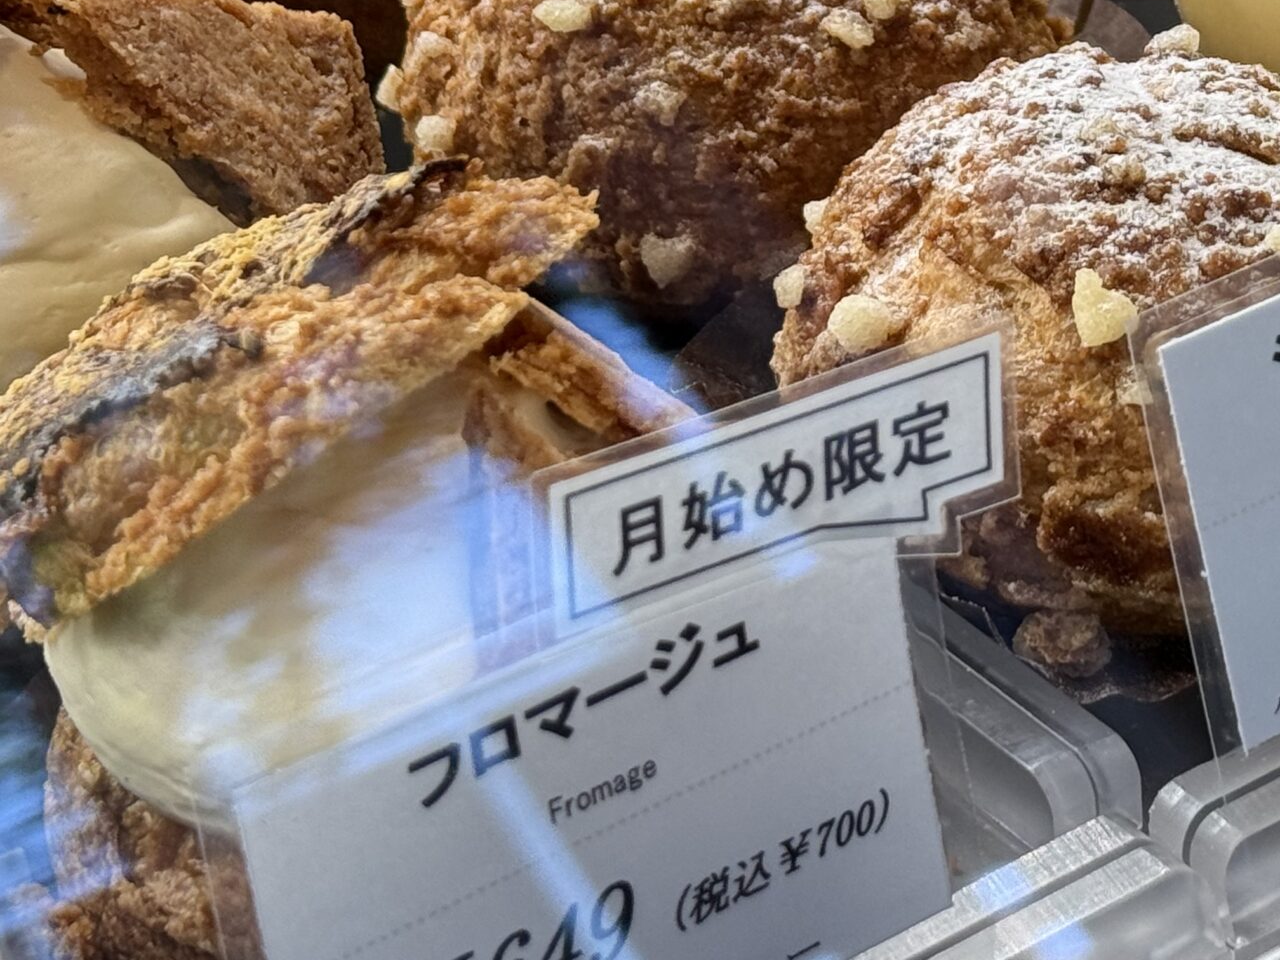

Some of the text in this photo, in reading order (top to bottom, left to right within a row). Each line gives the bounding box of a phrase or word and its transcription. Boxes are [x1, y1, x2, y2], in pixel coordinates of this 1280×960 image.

[613, 400, 952, 577] 月始め限定
[408, 622, 760, 808] フロマージュ
[548, 759, 657, 825] Fromage
